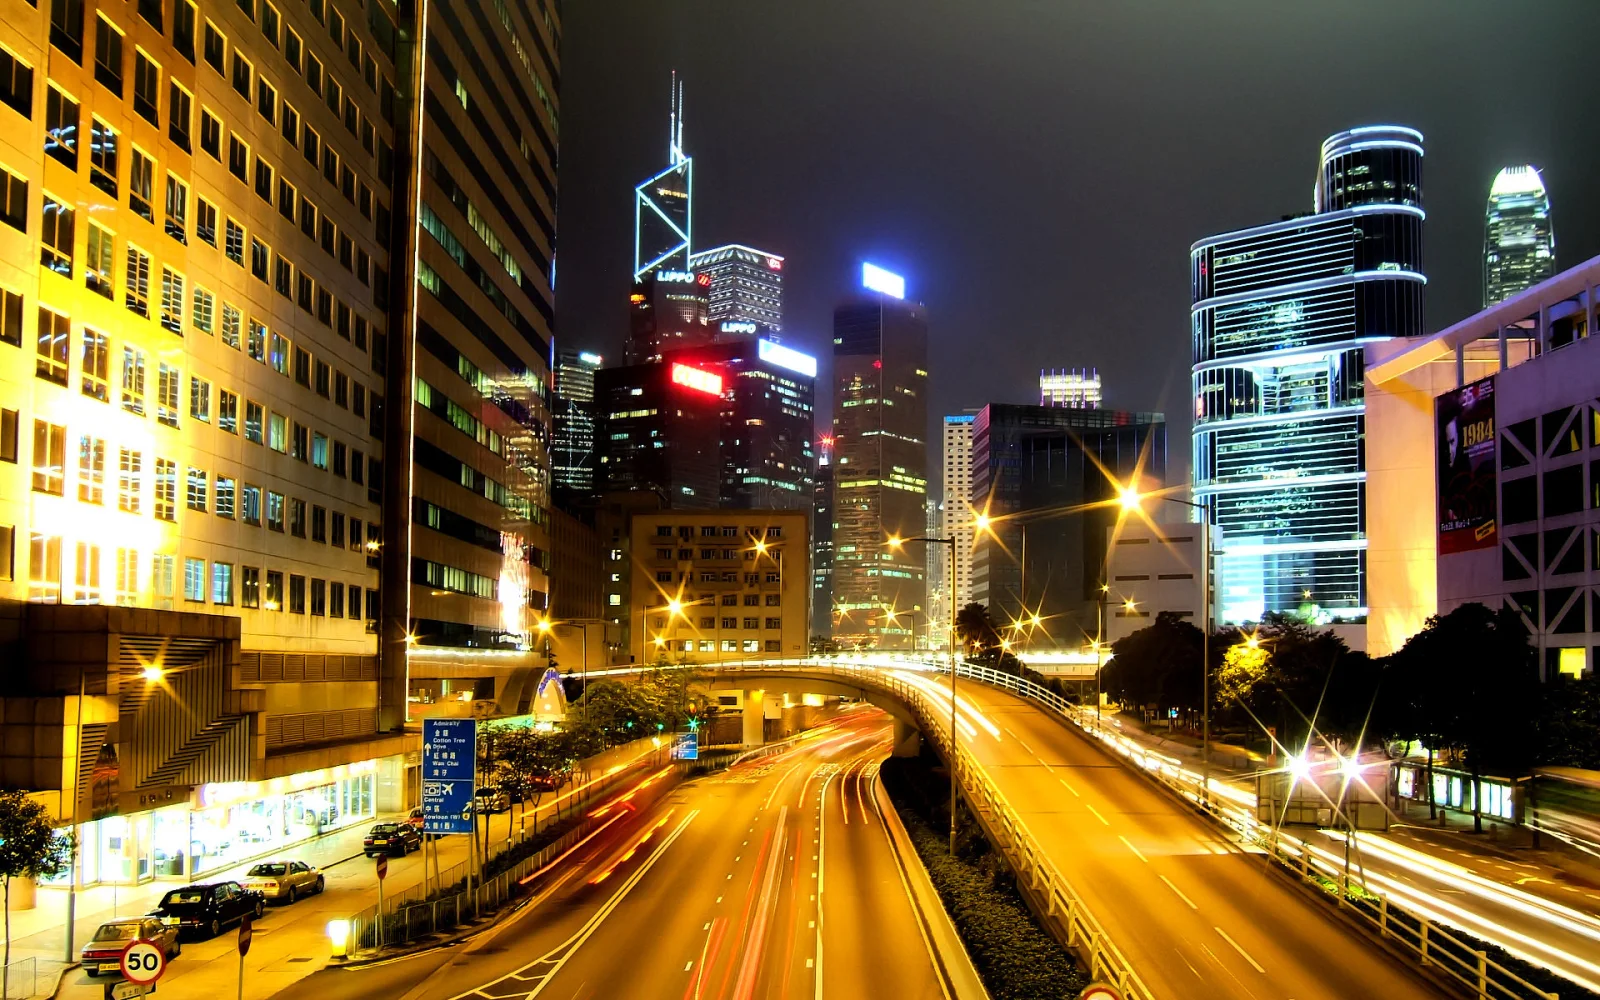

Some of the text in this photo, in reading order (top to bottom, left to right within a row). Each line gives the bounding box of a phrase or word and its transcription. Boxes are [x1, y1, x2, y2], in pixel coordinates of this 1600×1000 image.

[657, 271, 695, 283] LIPPO
[721, 322, 757, 334] LIPPO
[1463, 418, 1494, 448] 1984
[127, 953, 158, 971] 50
